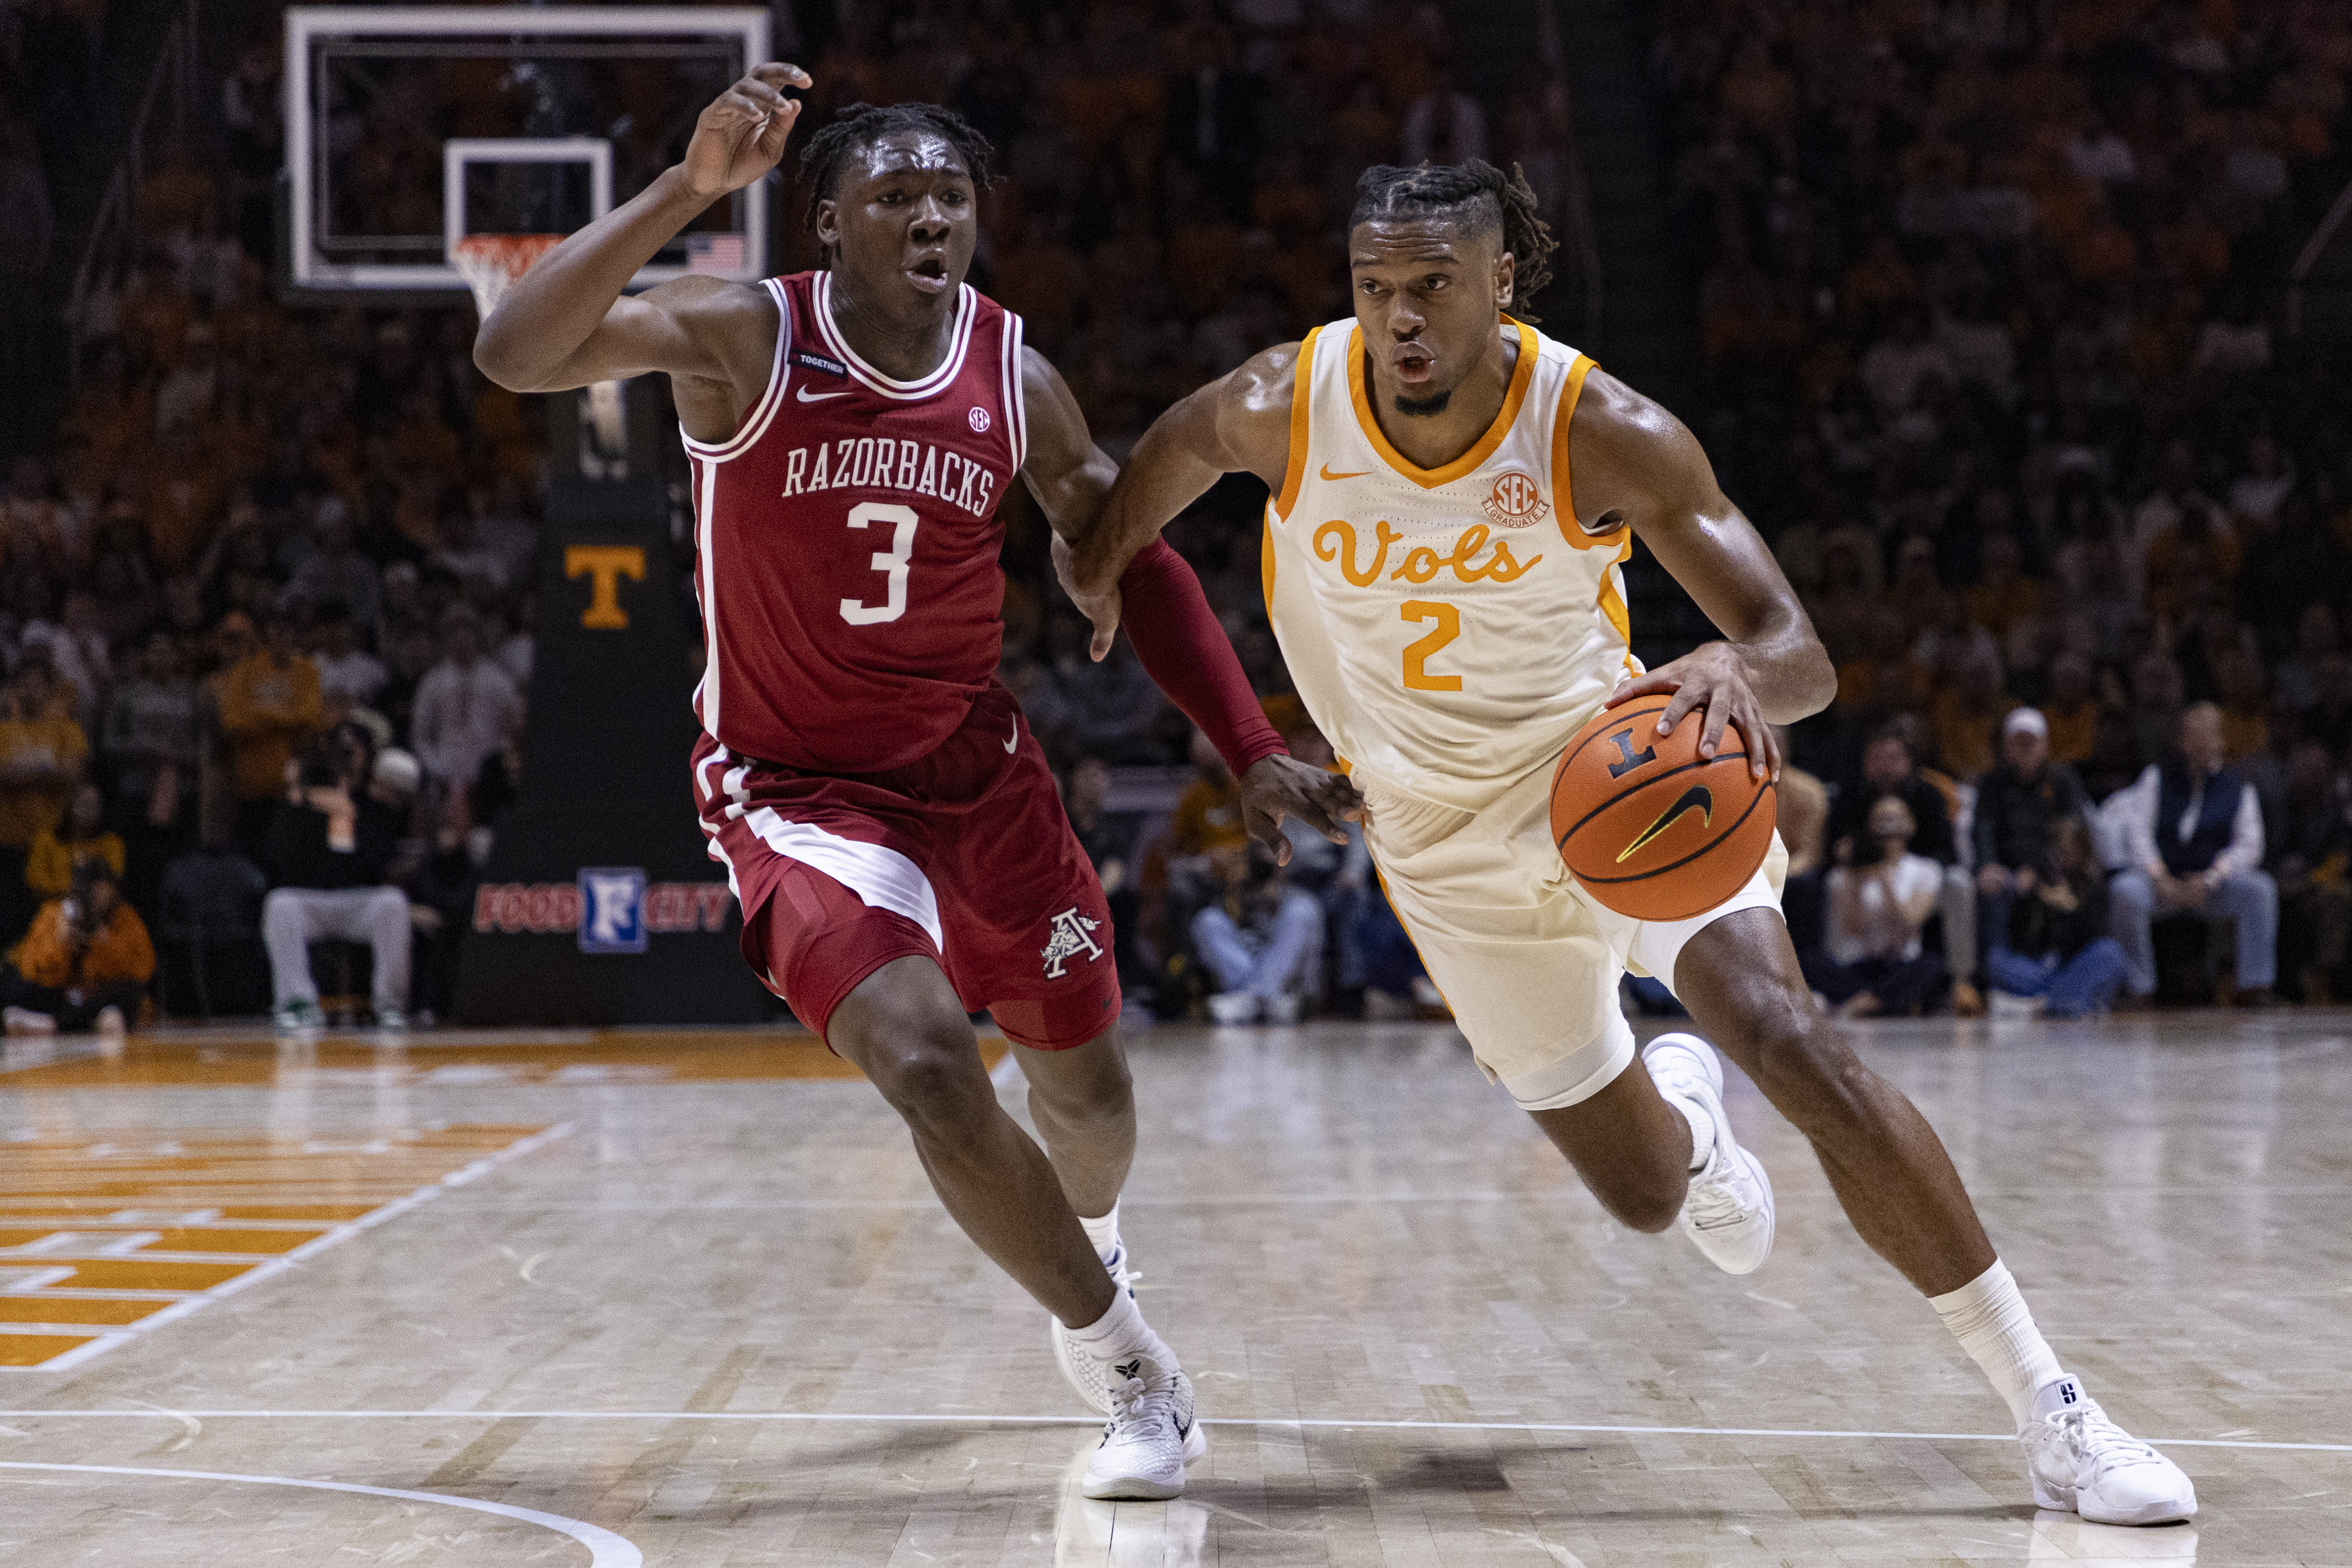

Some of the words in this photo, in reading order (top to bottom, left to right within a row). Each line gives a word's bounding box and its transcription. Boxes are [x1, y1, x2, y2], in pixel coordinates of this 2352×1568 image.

[800, 354, 844, 374] TOGETHER
[970, 408, 989, 431] SEC
[782, 437, 994, 517] RAZORBACKS
[1495, 475, 1535, 514] SEC
[1489, 509, 1540, 527] GRADUATE
[564, 545, 646, 629] T
[839, 501, 919, 626] 3
[1312, 520, 1544, 588] Vols
[1400, 599, 1463, 692] 2
[473, 882, 581, 933] FOOD
[645, 882, 734, 933] CITY
[1047, 906, 1103, 979] A
